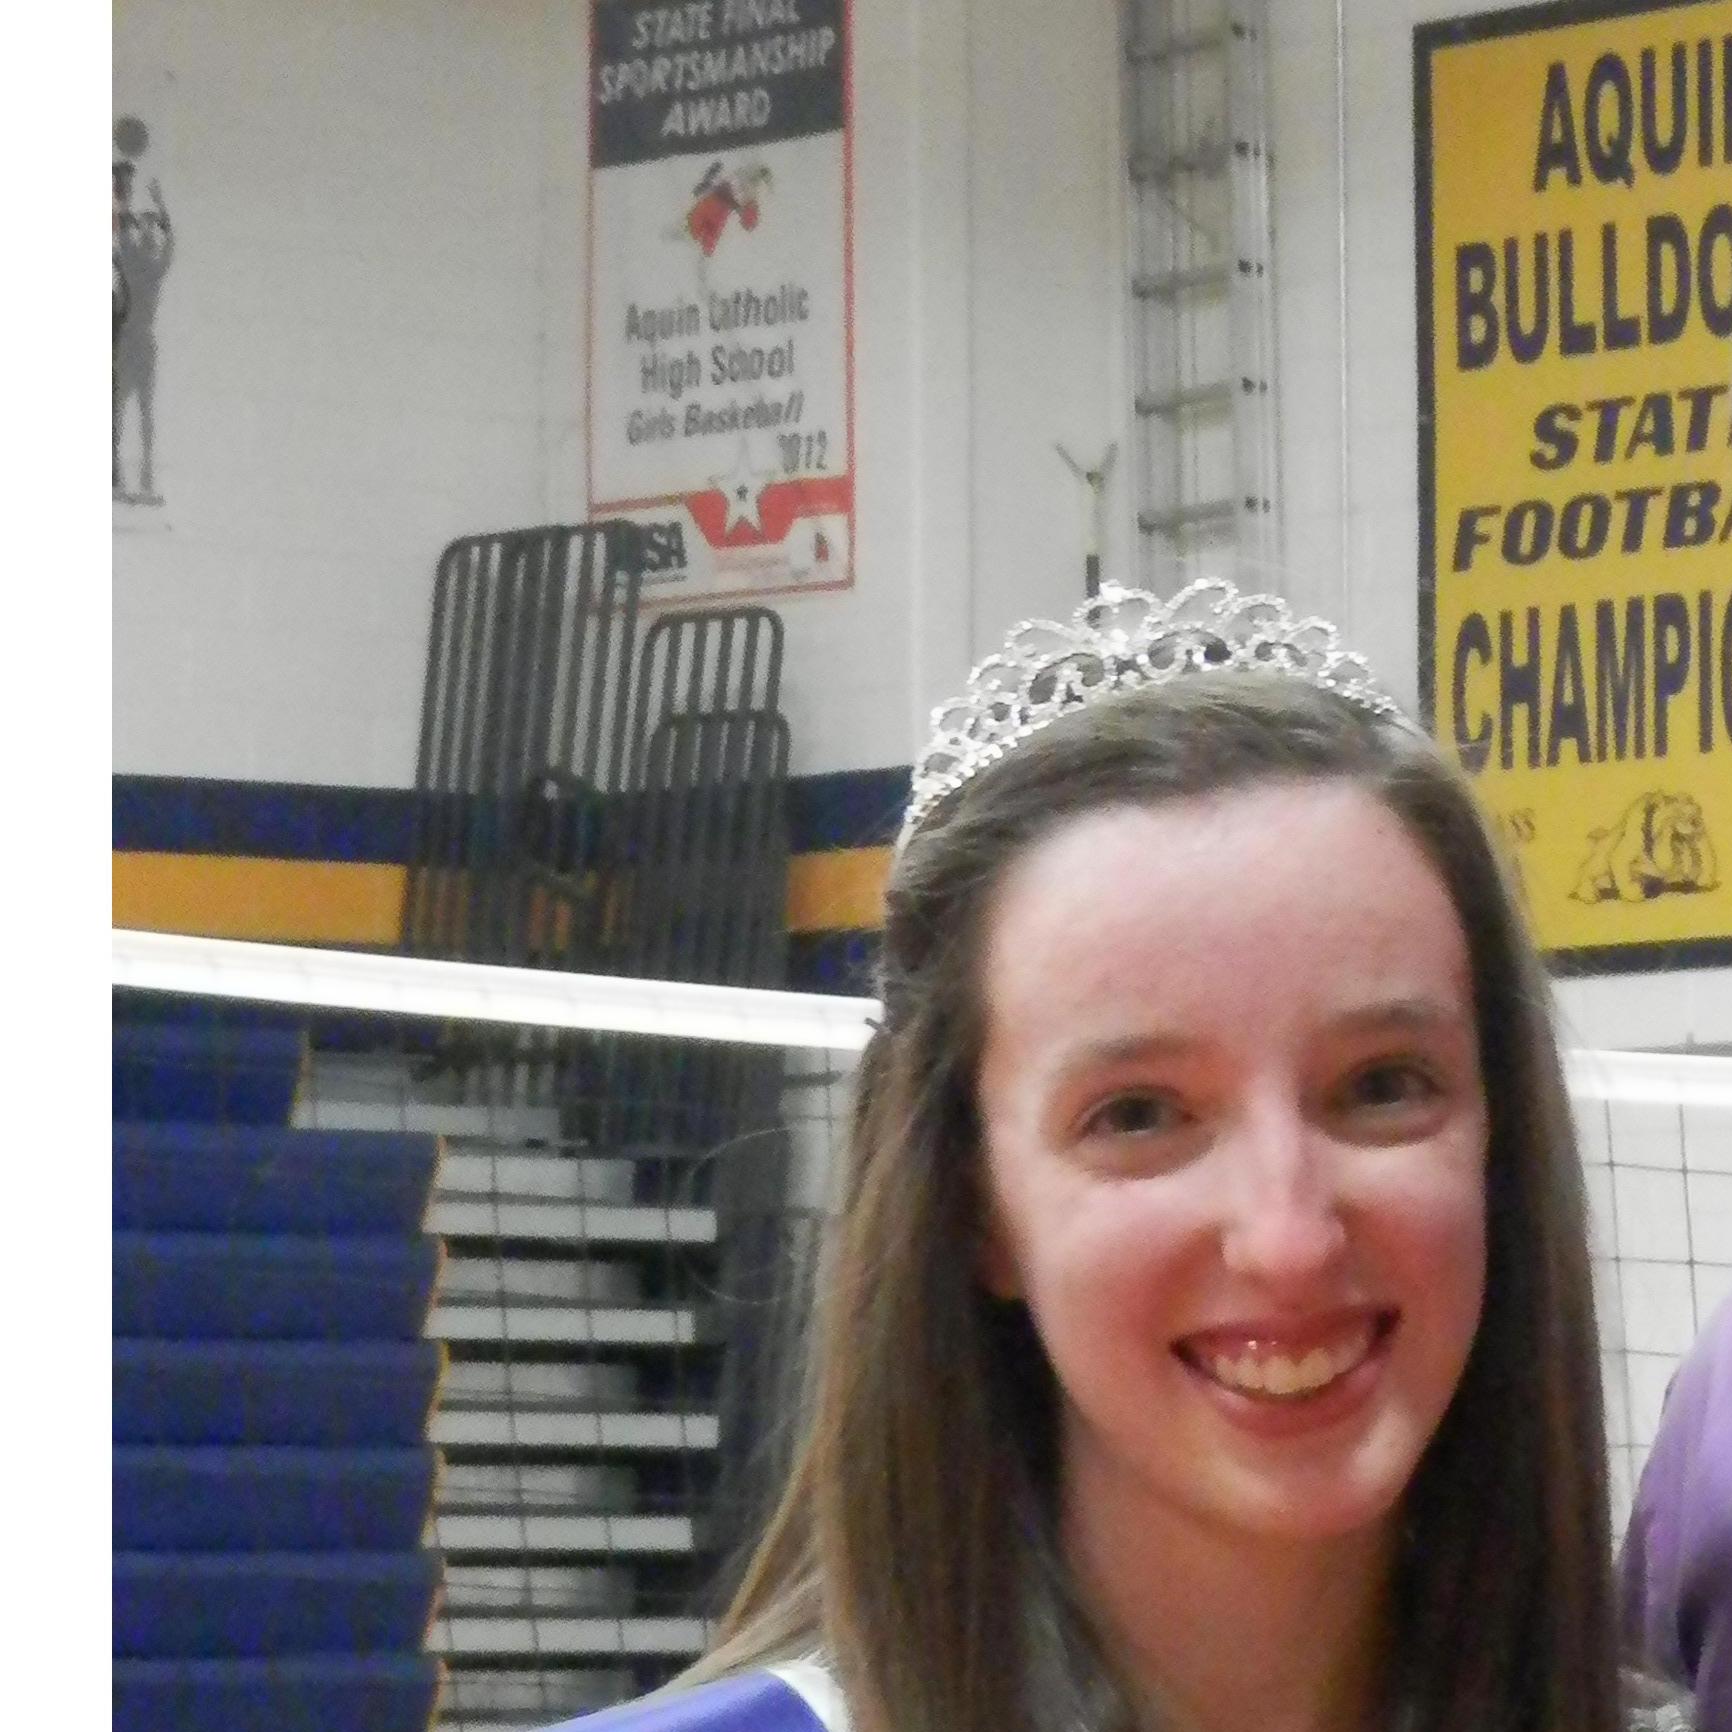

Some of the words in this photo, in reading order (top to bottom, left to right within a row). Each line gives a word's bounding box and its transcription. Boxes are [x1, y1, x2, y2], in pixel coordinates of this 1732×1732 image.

[632, 2, 714, 51] STATE
[600, 26, 836, 104] SPORTSMANSHIP
[659, 87, 772, 136] AWARD
[625, 302, 702, 346] Aquin
[640, 350, 702, 401] High
[711, 336, 795, 386] School
[684, 390, 805, 438] Basketball
